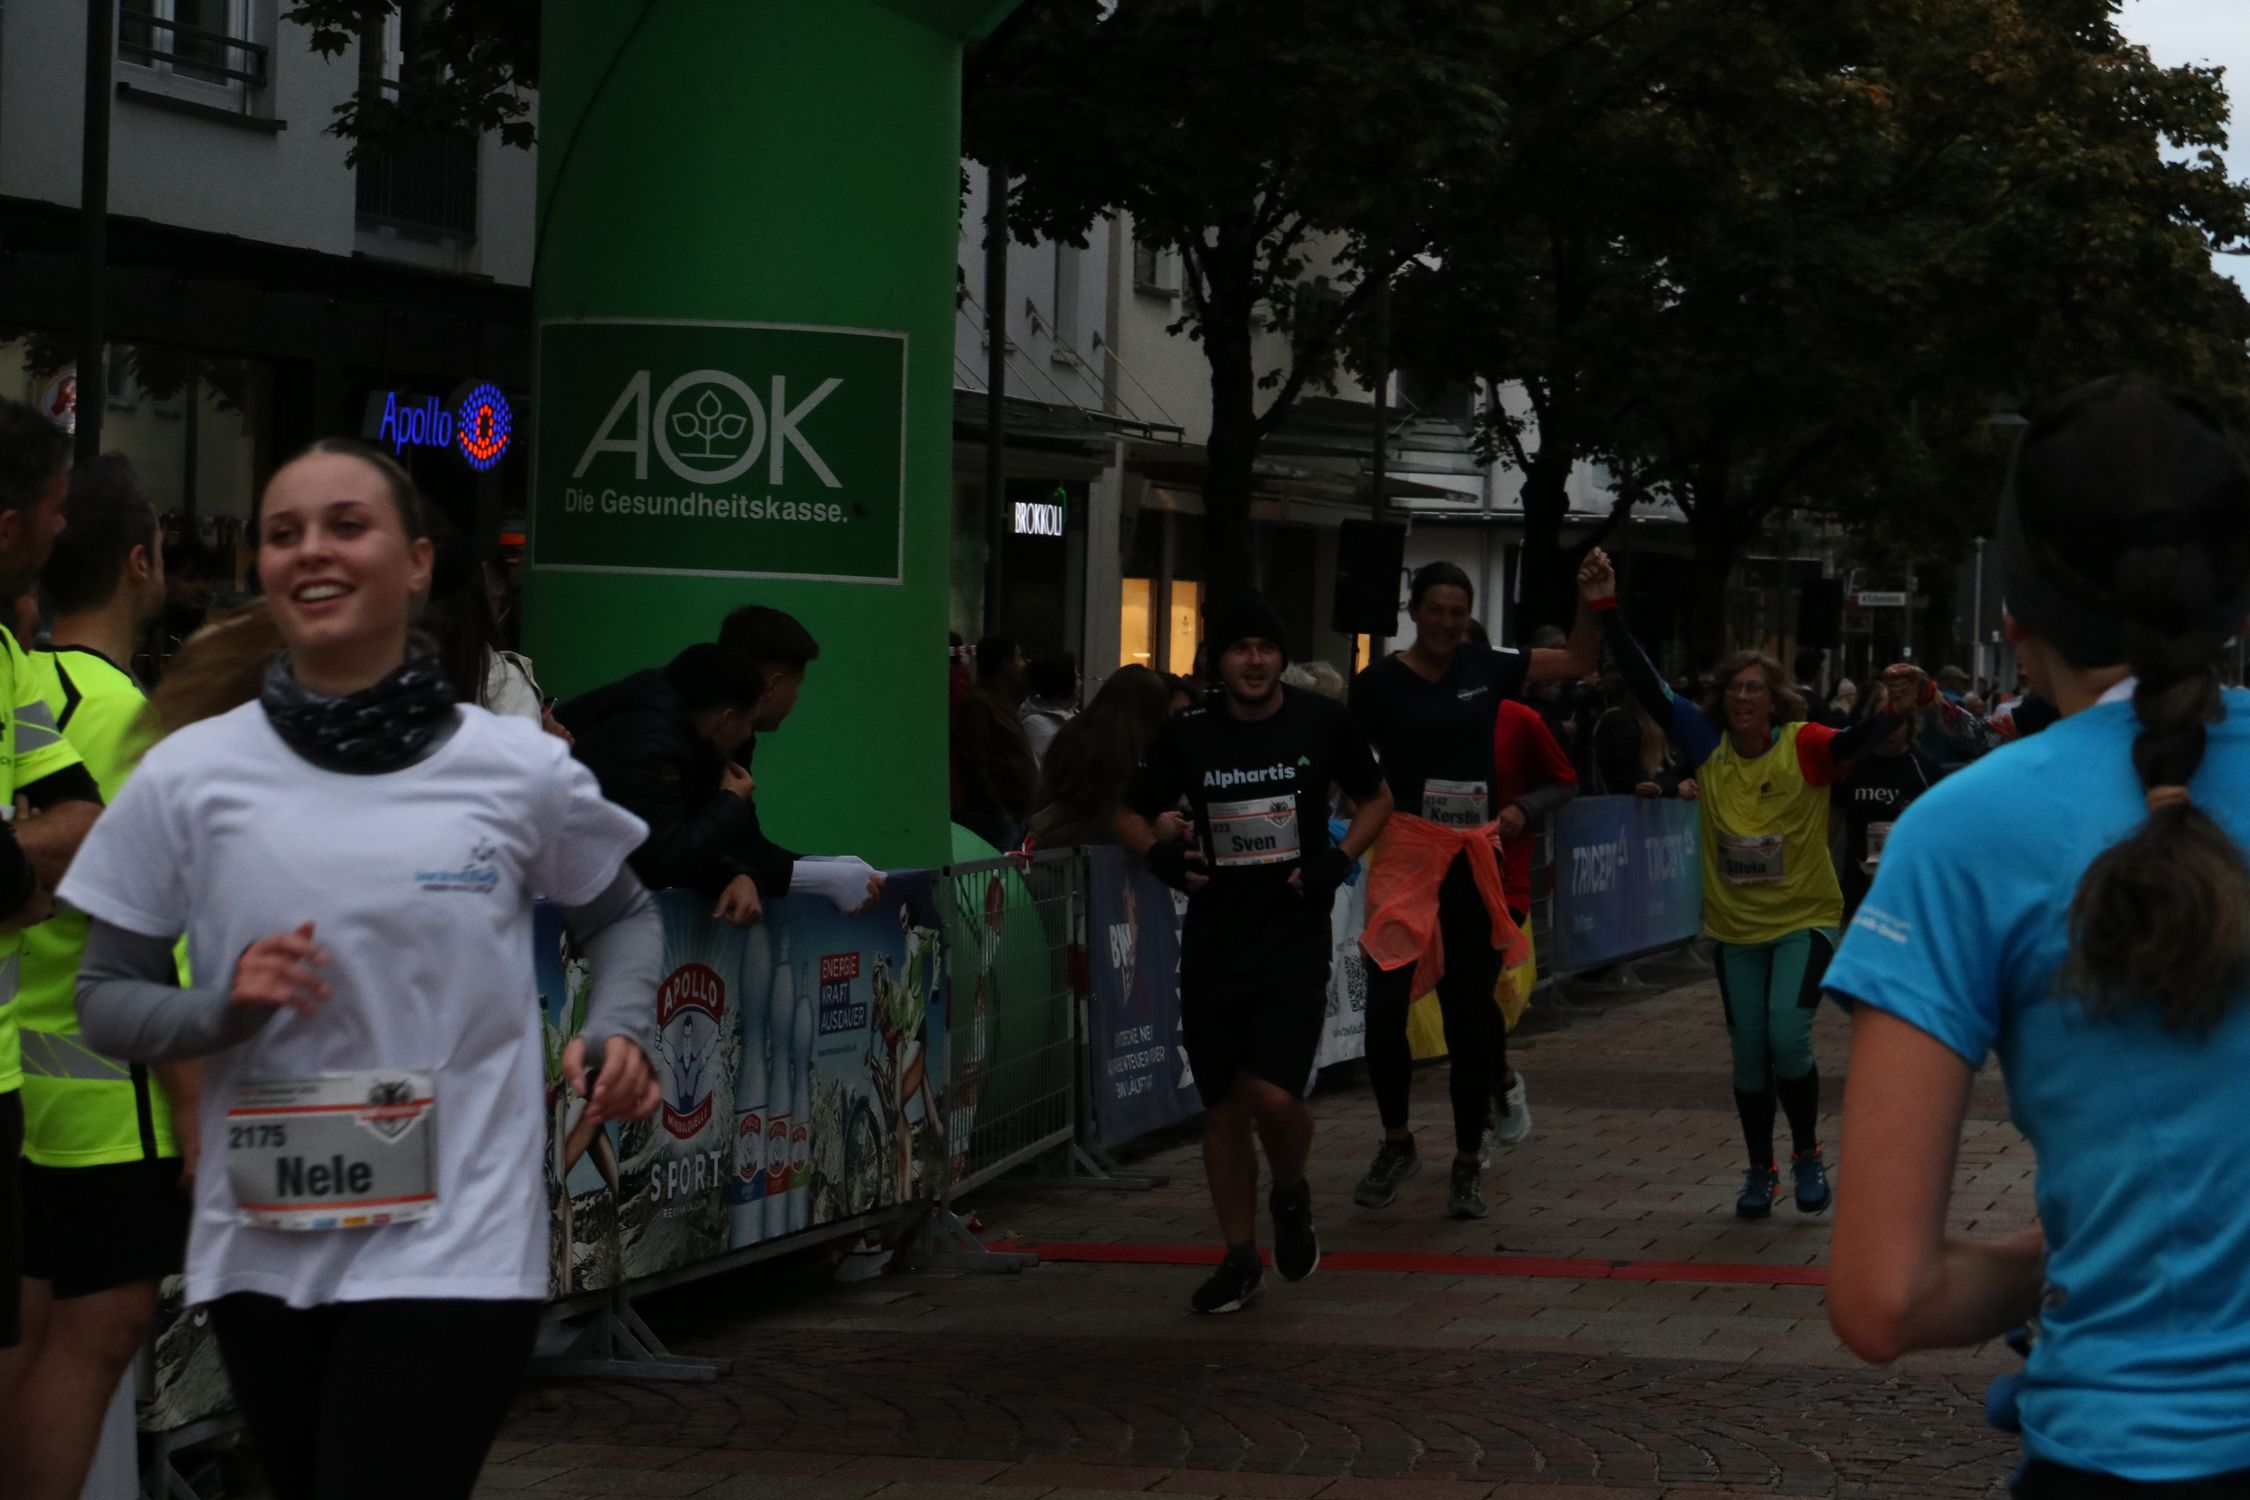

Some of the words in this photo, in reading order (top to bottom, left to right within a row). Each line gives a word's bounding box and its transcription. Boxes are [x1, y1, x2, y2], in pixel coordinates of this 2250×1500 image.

[380, 391, 452, 456] Apollo
[571, 369, 845, 488] AOK
[565, 488, 594, 513] Die
[600, 488, 848, 523] Gesundheitskasse.
[1015, 502, 1062, 536] BROKKOLI
[1203, 762, 1296, 788] Alphartis
[1854, 786, 1899, 804] mey
[1431, 807, 1481, 824] Kerstin
[1232, 835, 1277, 852] Sven
[1726, 860, 1766, 876] Silvia
[821, 955, 857, 980] ENERGIE
[663, 971, 718, 1017] APOLLO
[822, 983, 849, 1005] KRAFT
[820, 1006, 864, 1033] AUSDAUER
[230, 1125, 286, 1148] 2175
[277, 1154, 372, 1197] Nele
[650, 1151, 721, 1201] SPORT
